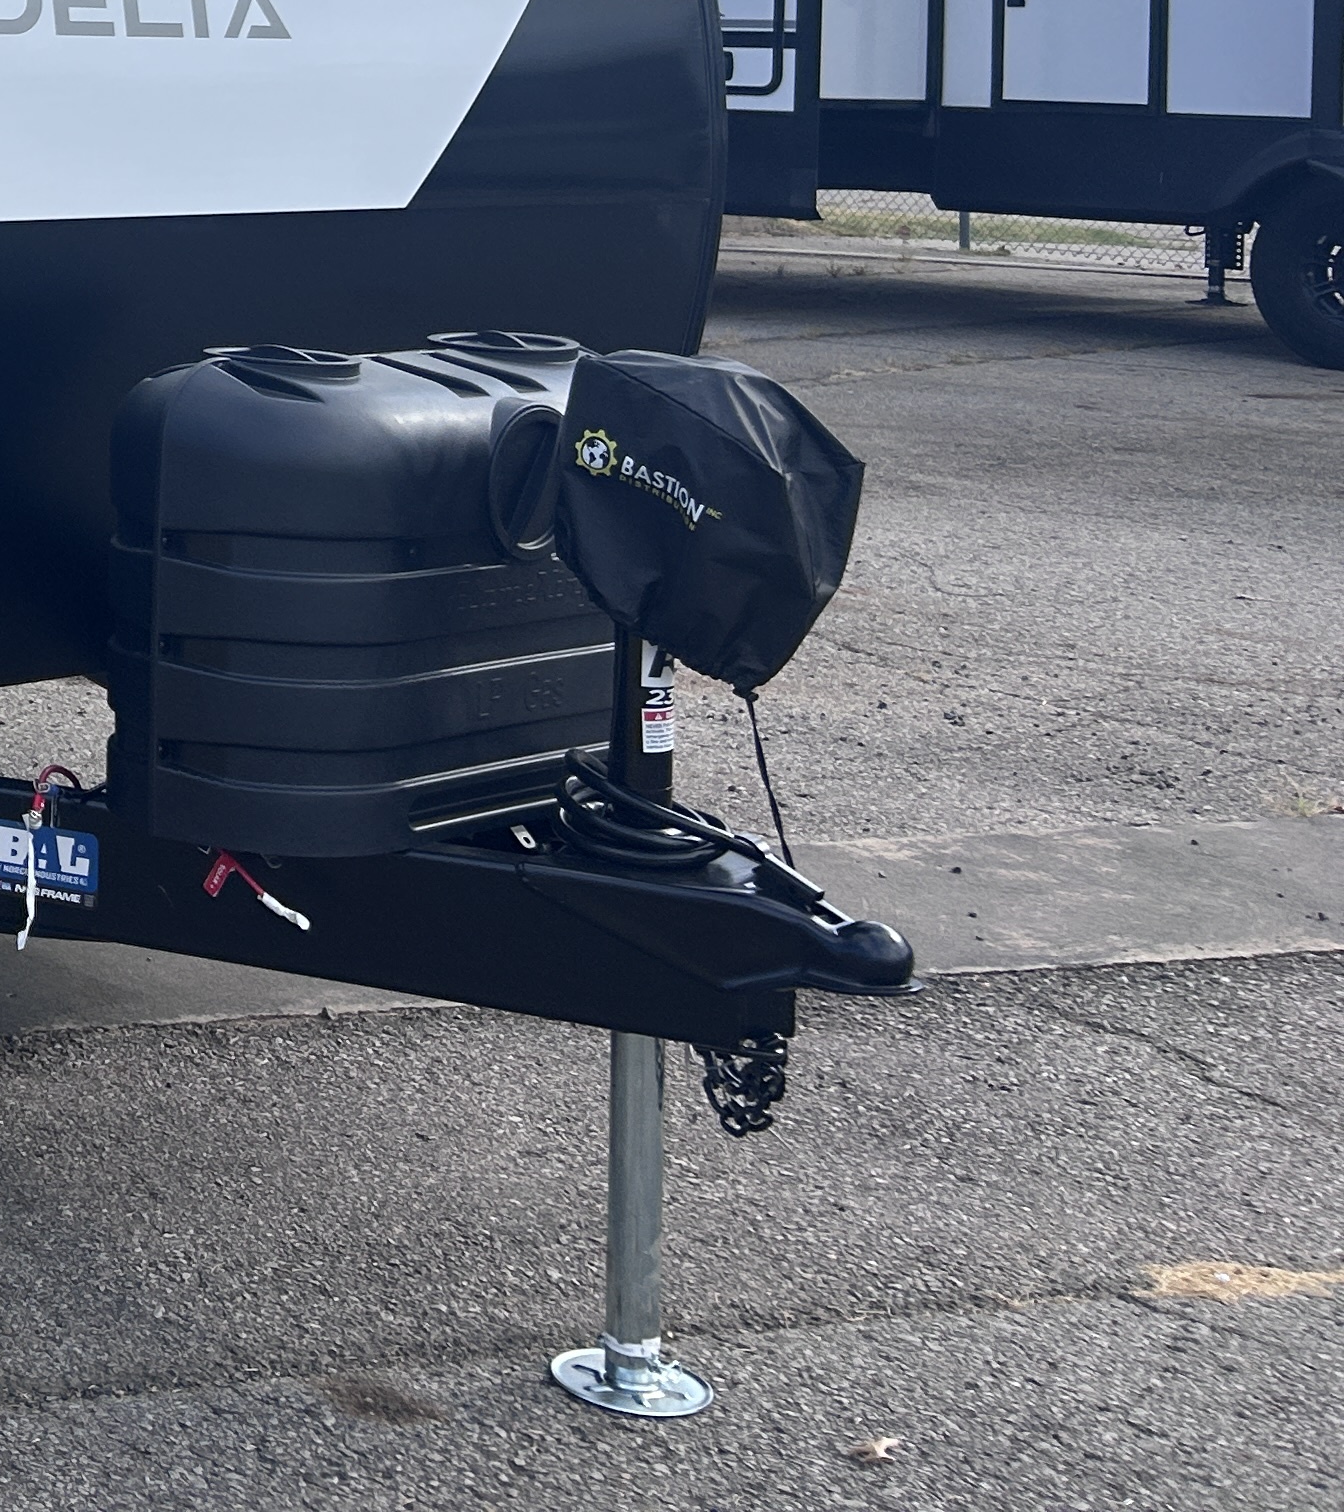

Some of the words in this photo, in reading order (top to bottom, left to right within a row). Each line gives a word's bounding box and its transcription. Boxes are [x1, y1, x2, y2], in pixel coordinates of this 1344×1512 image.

[620, 455, 705, 523] BASTION
[34, 870, 80, 886] NDUSTRIES
[40, 888, 82, 904] FRAME
